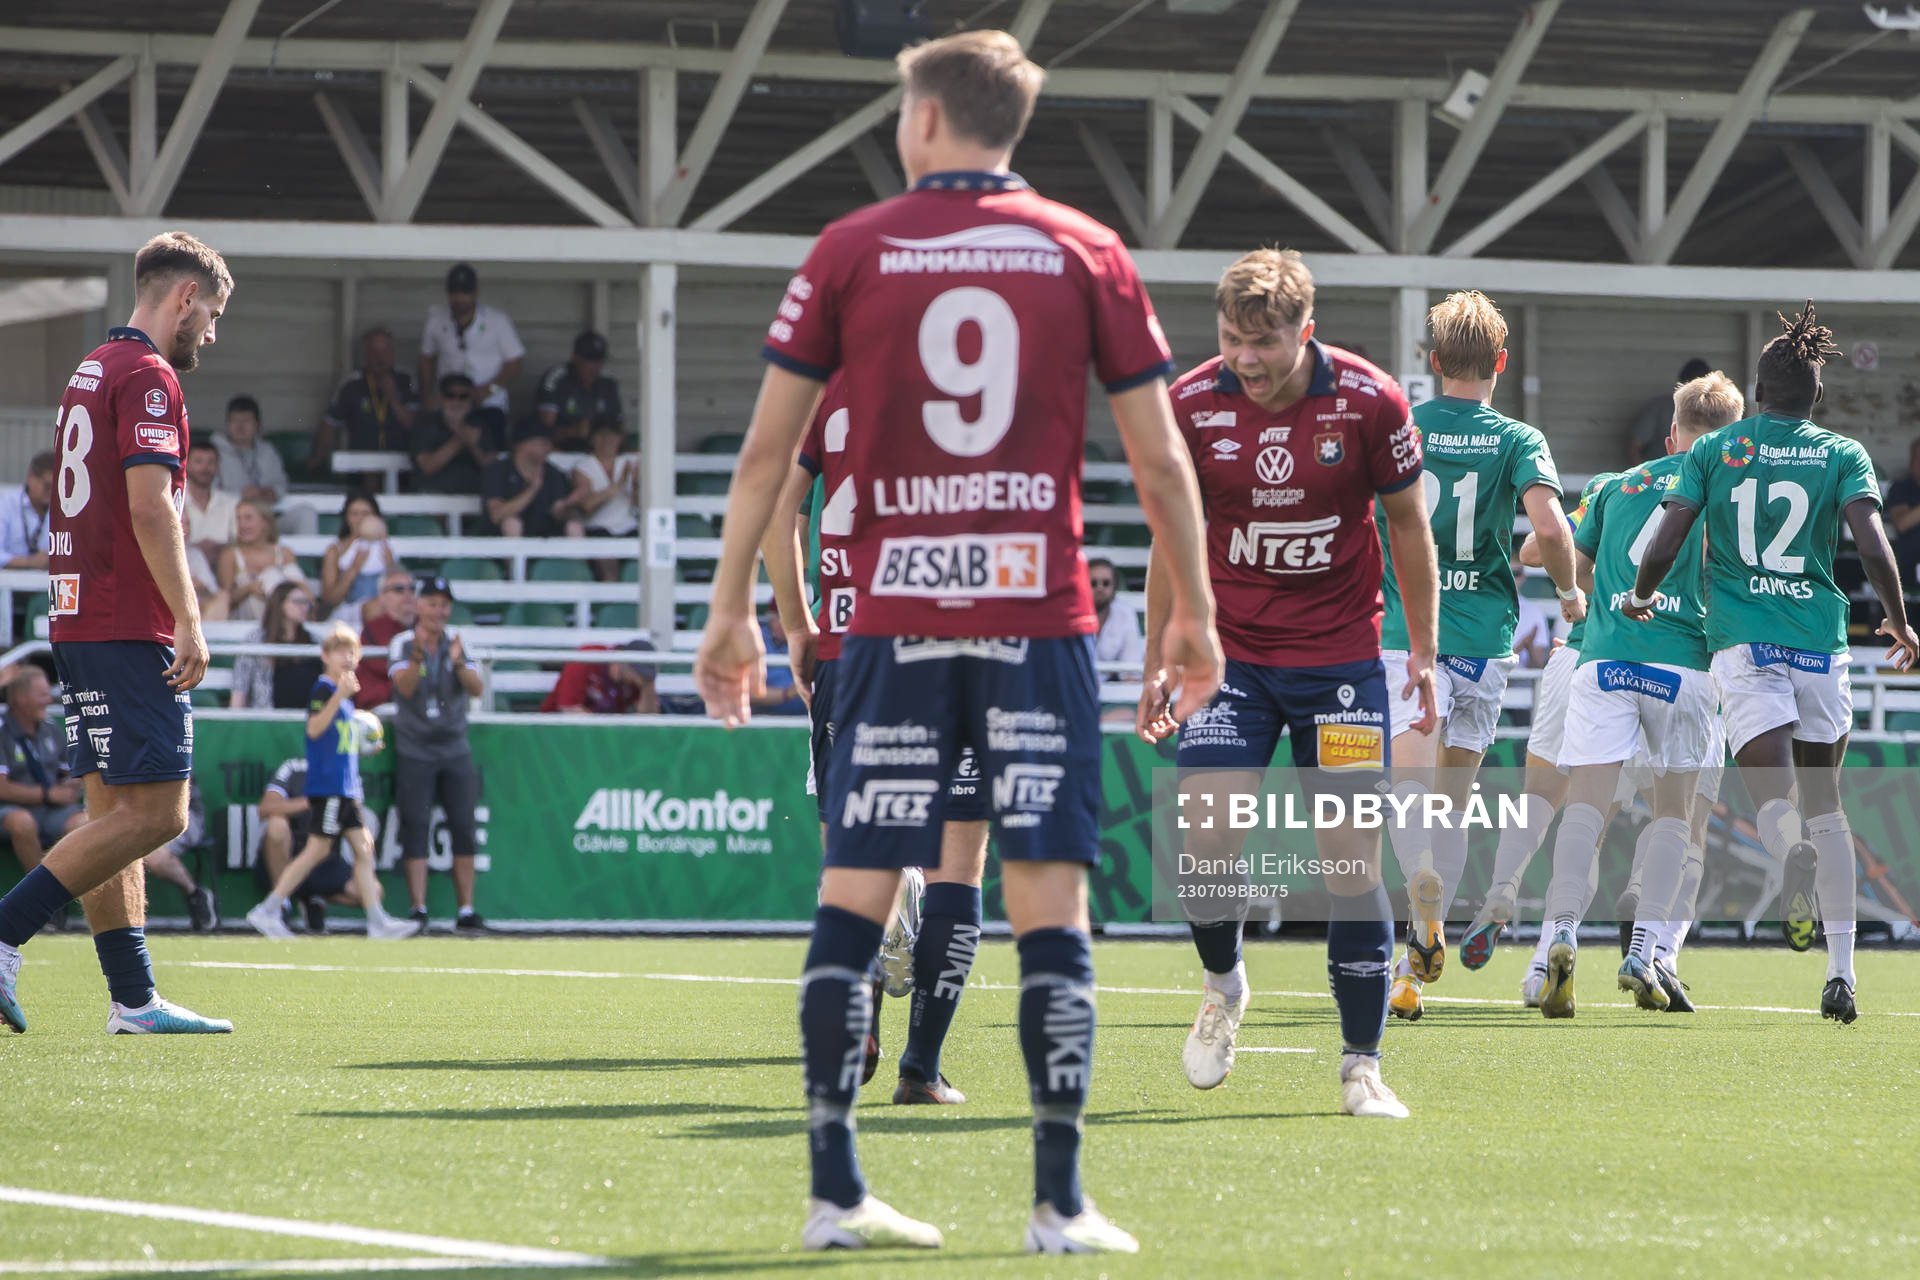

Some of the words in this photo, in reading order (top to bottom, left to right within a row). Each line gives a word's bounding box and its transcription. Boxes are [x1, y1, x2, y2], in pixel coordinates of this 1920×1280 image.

[879, 248, 1065, 276] HAMMARVIKEN
[918, 285, 1021, 458] 9
[139, 427, 175, 440] UNIBET
[1426, 443, 1438, 452] för
[1428, 432, 1468, 447] GLOBALA
[1470, 433, 1501, 447] MÅLEN
[1759, 443, 1797, 459] GLOBALA
[1798, 445, 1829, 459] MÅLEN
[873, 471, 1057, 517] LUNDBERG
[1251, 487, 1305, 501] factoring
[1730, 478, 1809, 573] 12
[1228, 514, 1341, 574] NTEX
[881, 544, 989, 589] BESAB
[1793, 653, 1825, 668] HEDIN
[1641, 680, 1671, 697] HEDIN
[1314, 708, 1384, 724] merinfo.se
[1322, 731, 1379, 747] TRIUMF
[1330, 746, 1371, 760] GLASS
[574, 788, 774, 832] AllKontor
[842, 779, 940, 828] NTEX
[726, 834, 773, 854] Mora
[933, 923, 982, 1001] MIKE
[911, 988, 927, 1028] umbro
[839, 983, 872, 1091] MIKE
[1043, 986, 1094, 1092] MIKE
